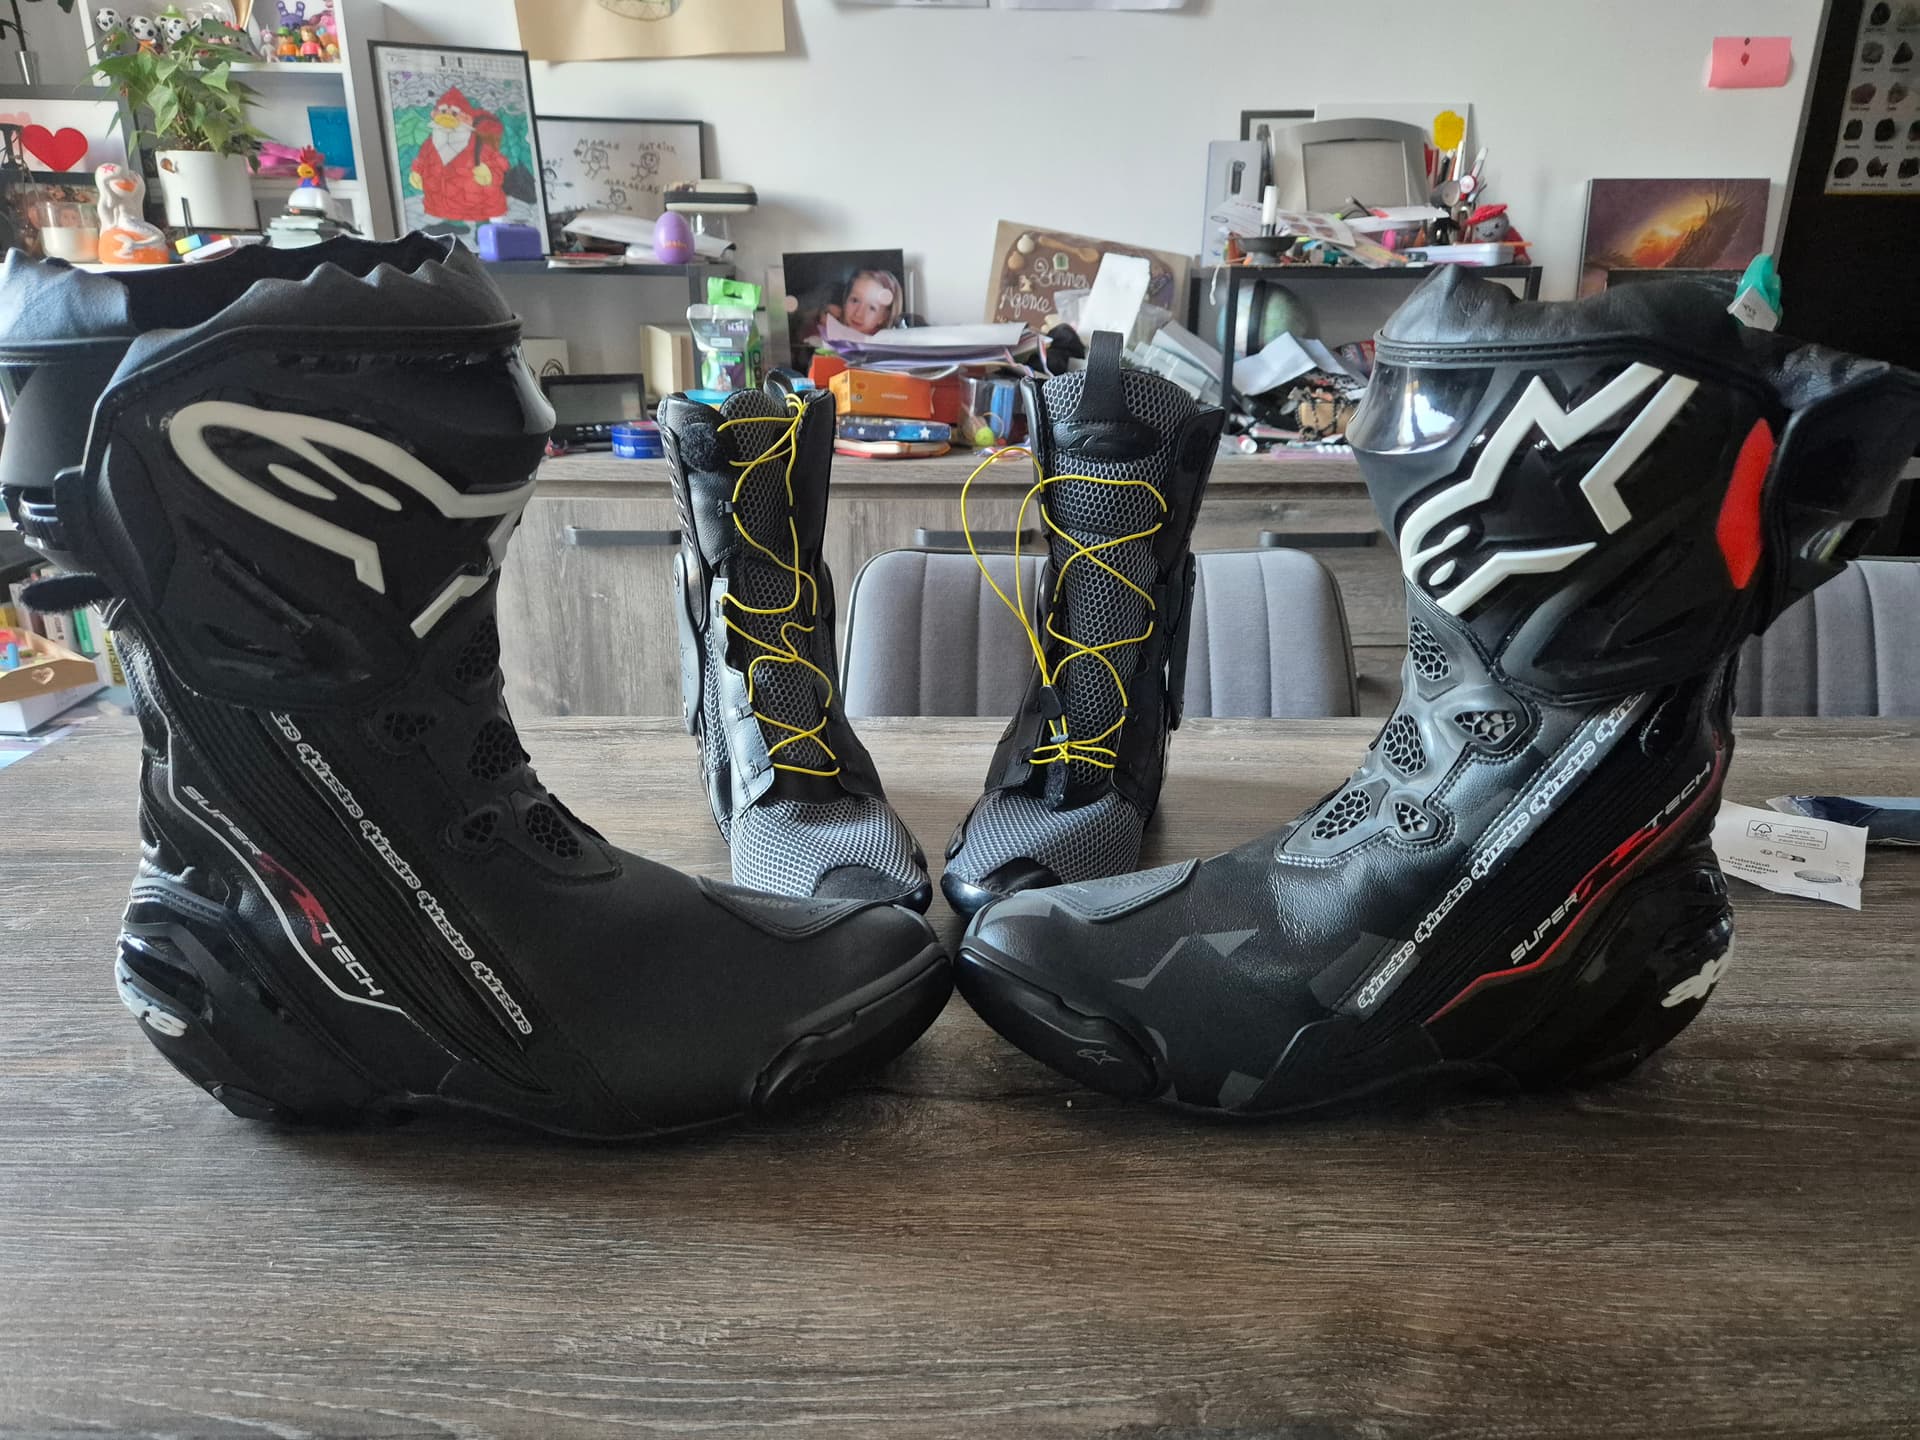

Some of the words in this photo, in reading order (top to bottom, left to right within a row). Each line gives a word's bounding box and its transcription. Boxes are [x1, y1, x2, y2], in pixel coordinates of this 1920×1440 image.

[181, 785, 262, 855] SUPER
[321, 922, 384, 996] TECH
[297, 743, 363, 818] alpinestars
[360, 820, 421, 889] alpinestars
[417, 890, 475, 960] alpinestars
[470, 961, 532, 1034] alpinestars
[1357, 940, 1416, 1008] alpinestars
[1414, 877, 1472, 943] alpinestars
[1471, 812, 1530, 880] alpinestars
[1530, 740, 1596, 814] alpinestars
[1510, 892, 1579, 965] SUPER
[1644, 761, 1710, 829] TECH
